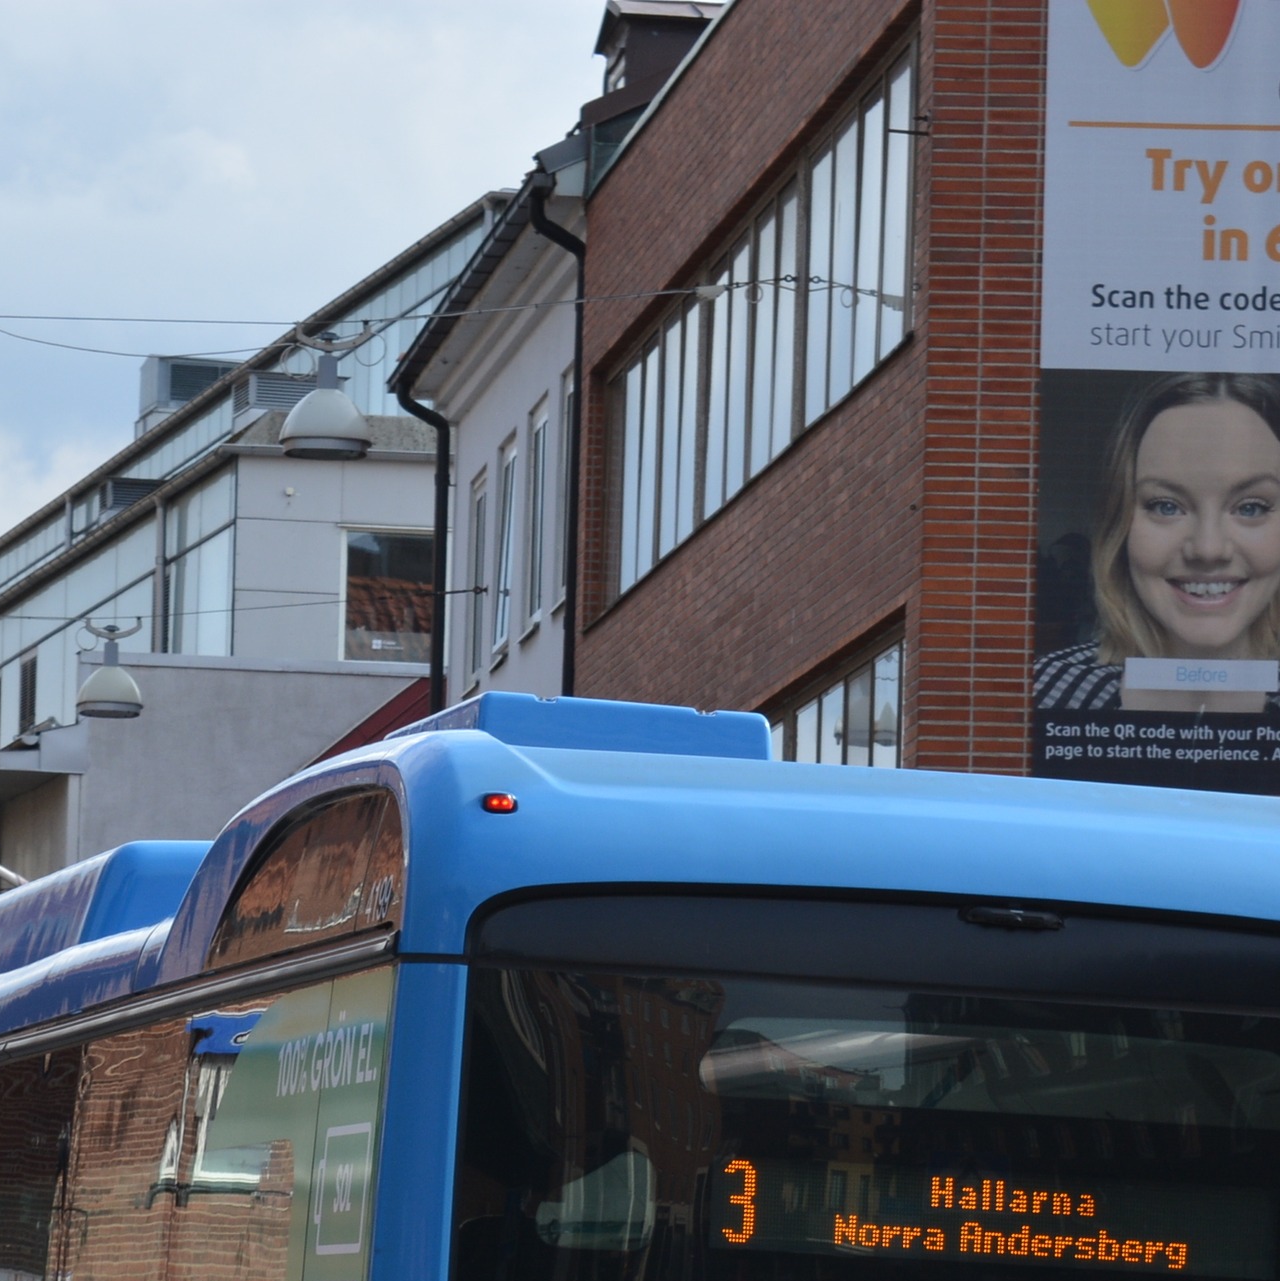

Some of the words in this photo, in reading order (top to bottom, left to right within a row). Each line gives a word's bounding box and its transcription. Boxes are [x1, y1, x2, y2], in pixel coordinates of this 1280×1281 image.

[1145, 148, 1229, 204] Try
[1203, 214, 1249, 261] in
[1091, 284, 1155, 309] Scan
[1164, 284, 1210, 310] the
[1090, 323, 1151, 347] start
[1161, 328, 1222, 353] your
[1176, 667, 1228, 683] Before
[1045, 722, 1080, 738] Scan
[1085, 723, 1110, 738] the
[1114, 724, 1135, 740] QR
[1139, 724, 1175, 739] code
[1180, 725, 1213, 740] with
[1218, 728, 1252, 743] your
[1045, 744, 1083, 760] page
[1087, 744, 1103, 757] to
[1106, 744, 1142, 758] start
[1146, 744, 1171, 759] the
[1175, 745, 1259, 762] experience
[276, 1035, 311, 1097] 100%
[311, 1010, 356, 1092] GRÖN
[356, 1022, 377, 1084] EL.
[333, 1164, 353, 1213] SOL
[722, 1160, 756, 1243] 3
[931, 1176, 1096, 1217] Hallarna
[834, 1214, 945, 1251] Norra
[960, 1221, 1187, 1269] Andersberg
